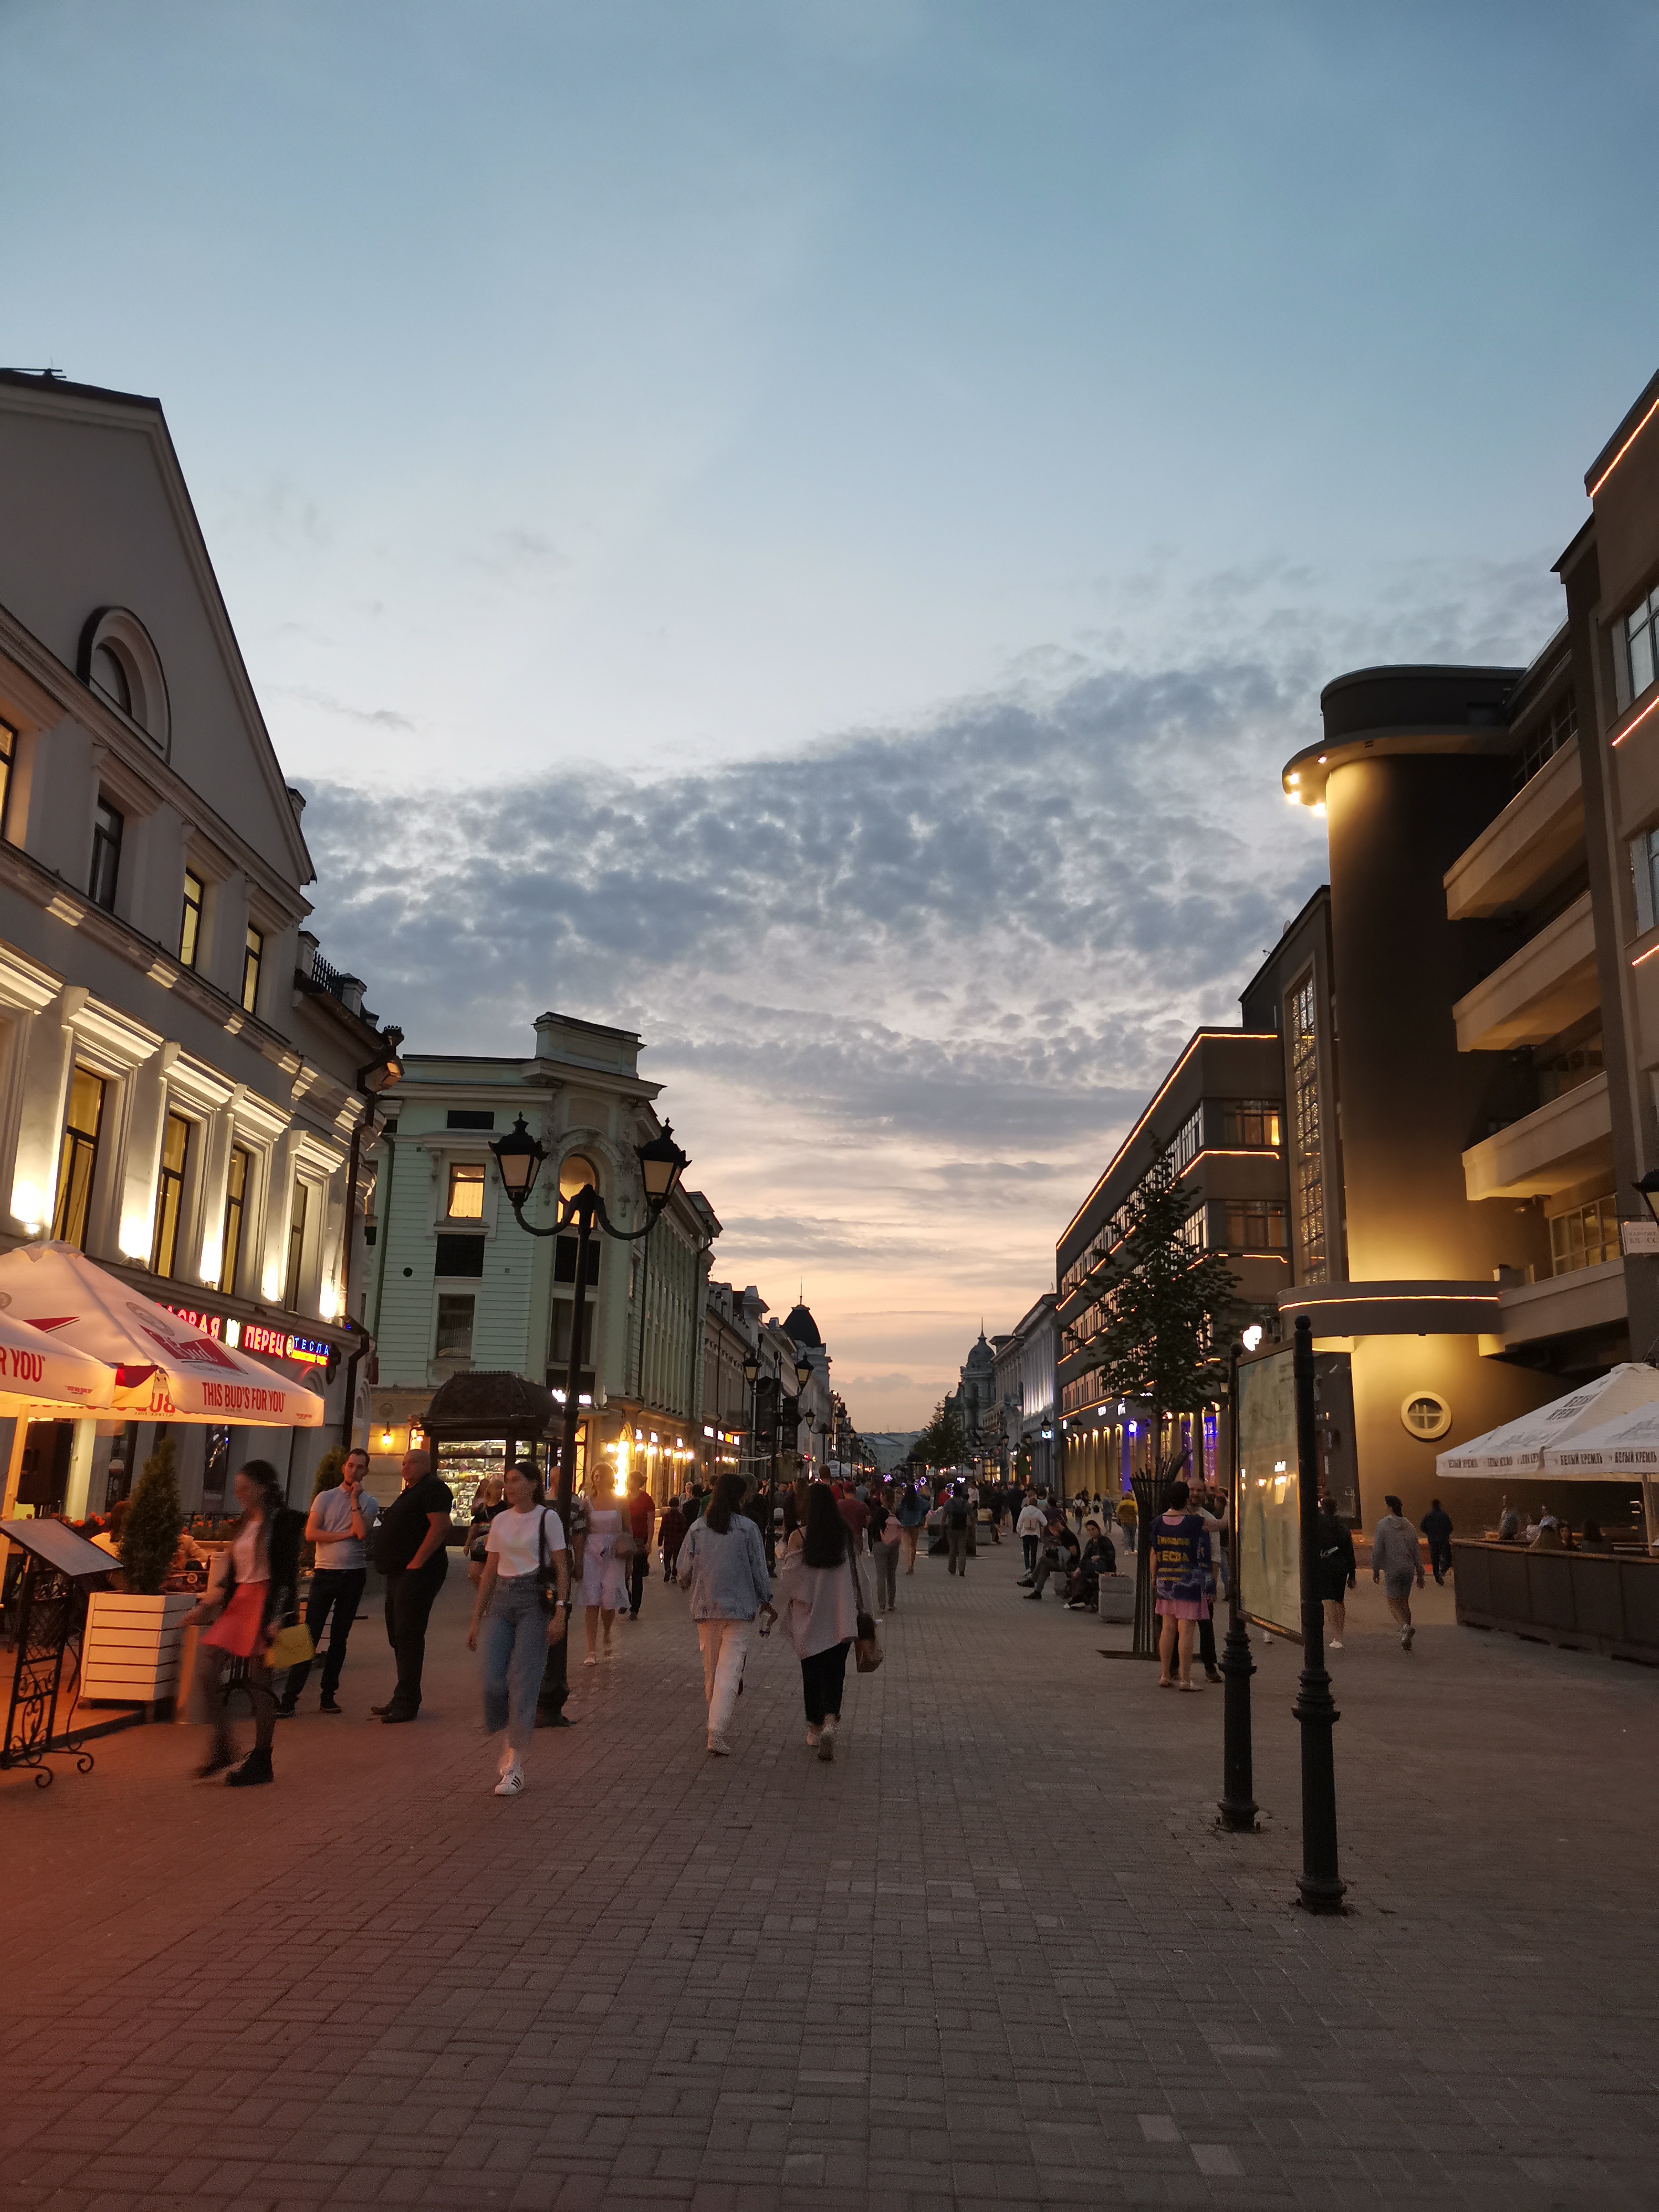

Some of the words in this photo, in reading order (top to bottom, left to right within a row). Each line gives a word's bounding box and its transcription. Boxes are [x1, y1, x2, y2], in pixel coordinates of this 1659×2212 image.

[244, 1325, 285, 1359] ПЕРЕЦ
[202, 1382, 222, 1407] THIS
[225, 1384, 250, 1410] BUD'S
[251, 1388, 267, 1411] FOR
[1560, 1452, 1579, 1465] БЕЛЫЙ
[1580, 1453, 1603, 1465] КРЕМЛЬ
[1615, 1451, 1634, 1463] БЕЛЫЙ
[1635, 1451, 1657, 1463] КРЕМЛЬ
